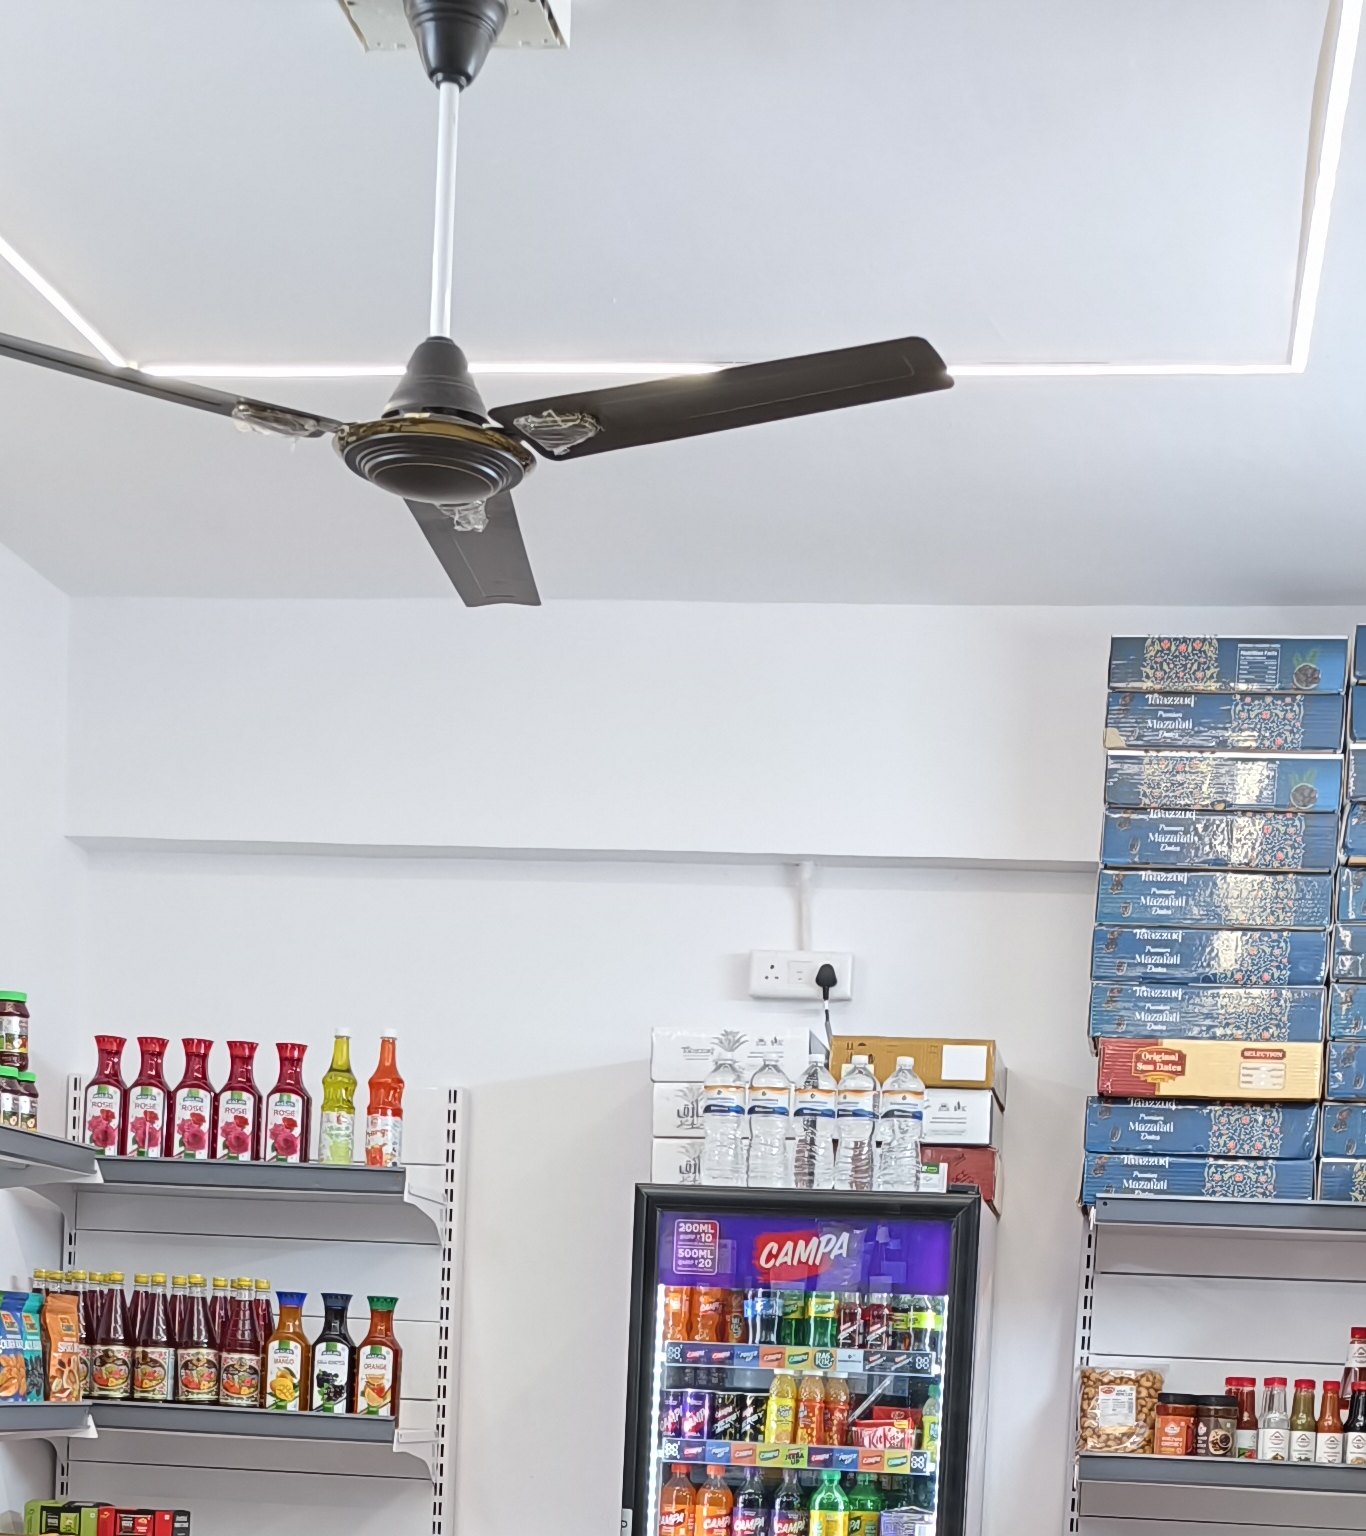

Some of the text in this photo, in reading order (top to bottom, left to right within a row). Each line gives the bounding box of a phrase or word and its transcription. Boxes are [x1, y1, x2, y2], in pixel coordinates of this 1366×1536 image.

[1141, 1052, 1179, 1063] Original
[1243, 1050, 1284, 1059] SELECTION
[1137, 1062, 1182, 1072] Sun Dates
[92, 1101, 114, 1109] ROSE
[134, 1102, 157, 1111] ROSE
[182, 1104, 204, 1113] ROSE
[225, 1107, 248, 1115] ROSE
[273, 1108, 296, 1117] ROSE
[678, 1223, 715, 1233] 200ML
[677, 1249, 714, 1259] 500ML
[759, 1231, 850, 1269] CAMPA
[660, 1514, 684, 1527] AMPA
